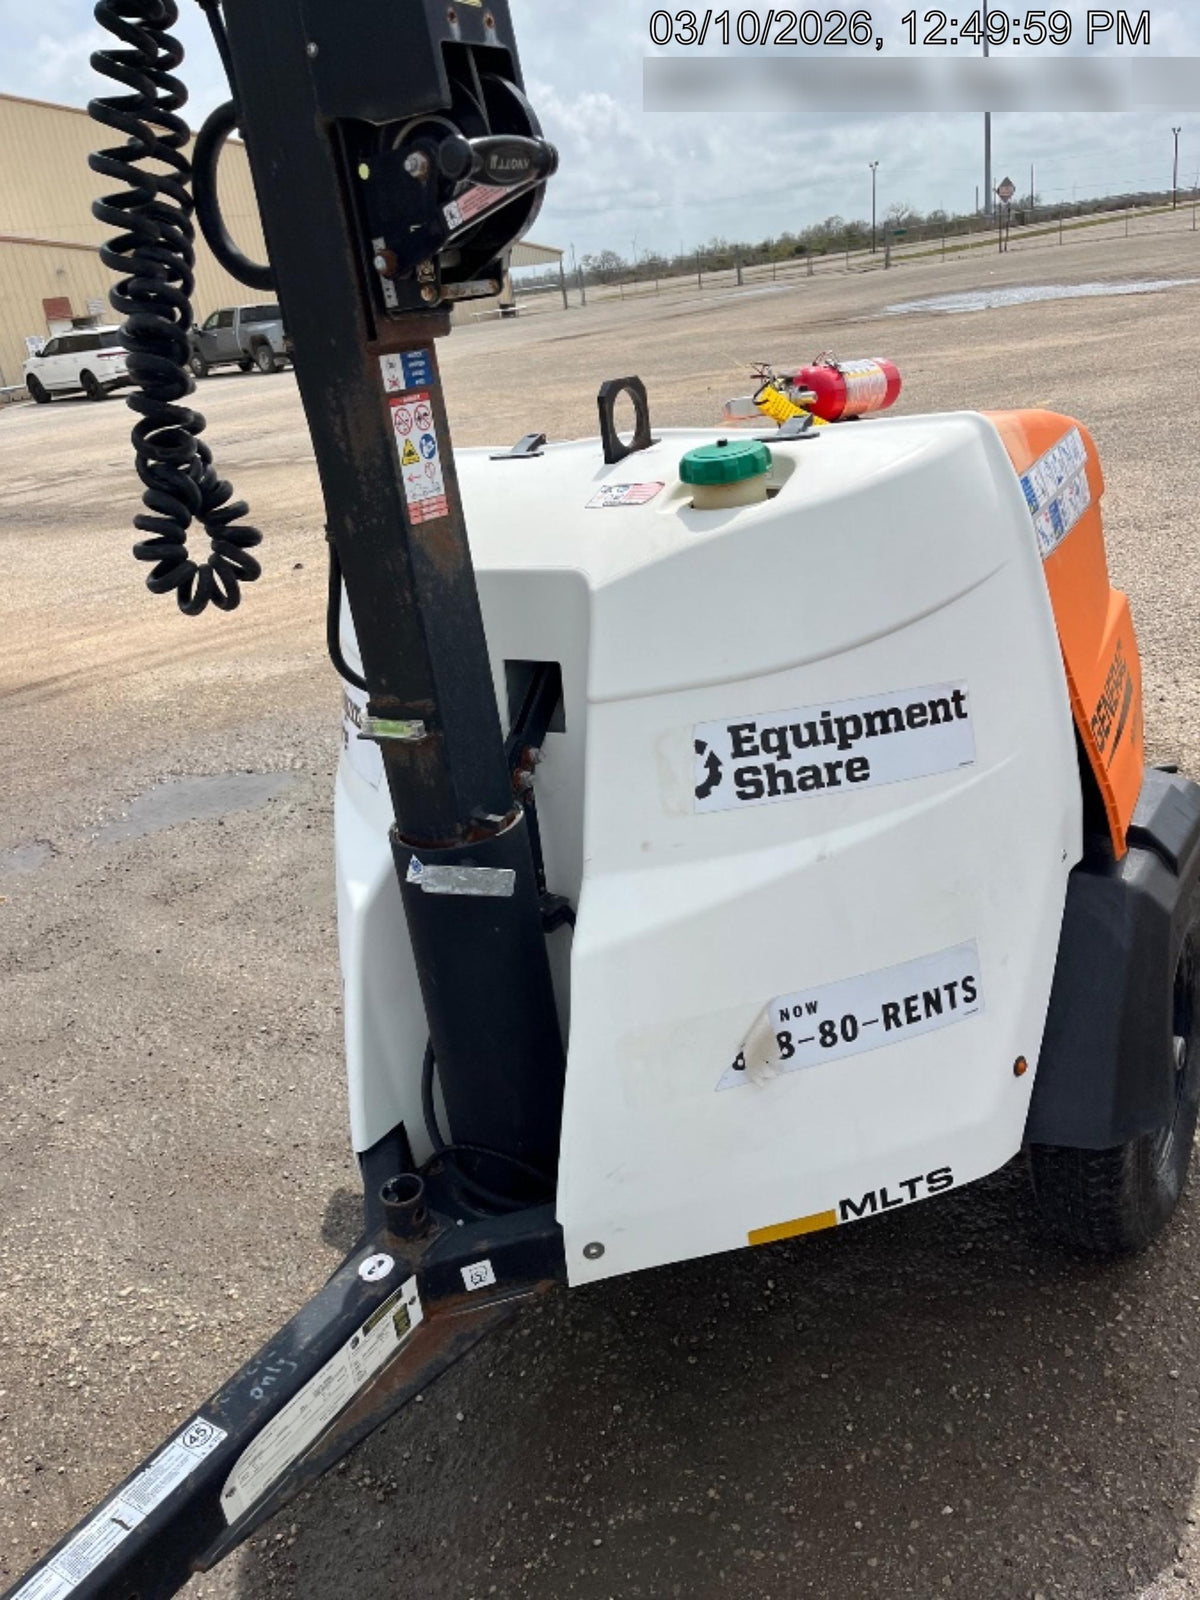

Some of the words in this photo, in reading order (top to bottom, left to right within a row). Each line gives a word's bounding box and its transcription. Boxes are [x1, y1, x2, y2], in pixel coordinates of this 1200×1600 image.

[727, 689, 968, 761] Equipment
[733, 755, 871, 801] Share
[779, 1000, 819, 1022] NOW
[838, 1165, 954, 1221] MLTS
